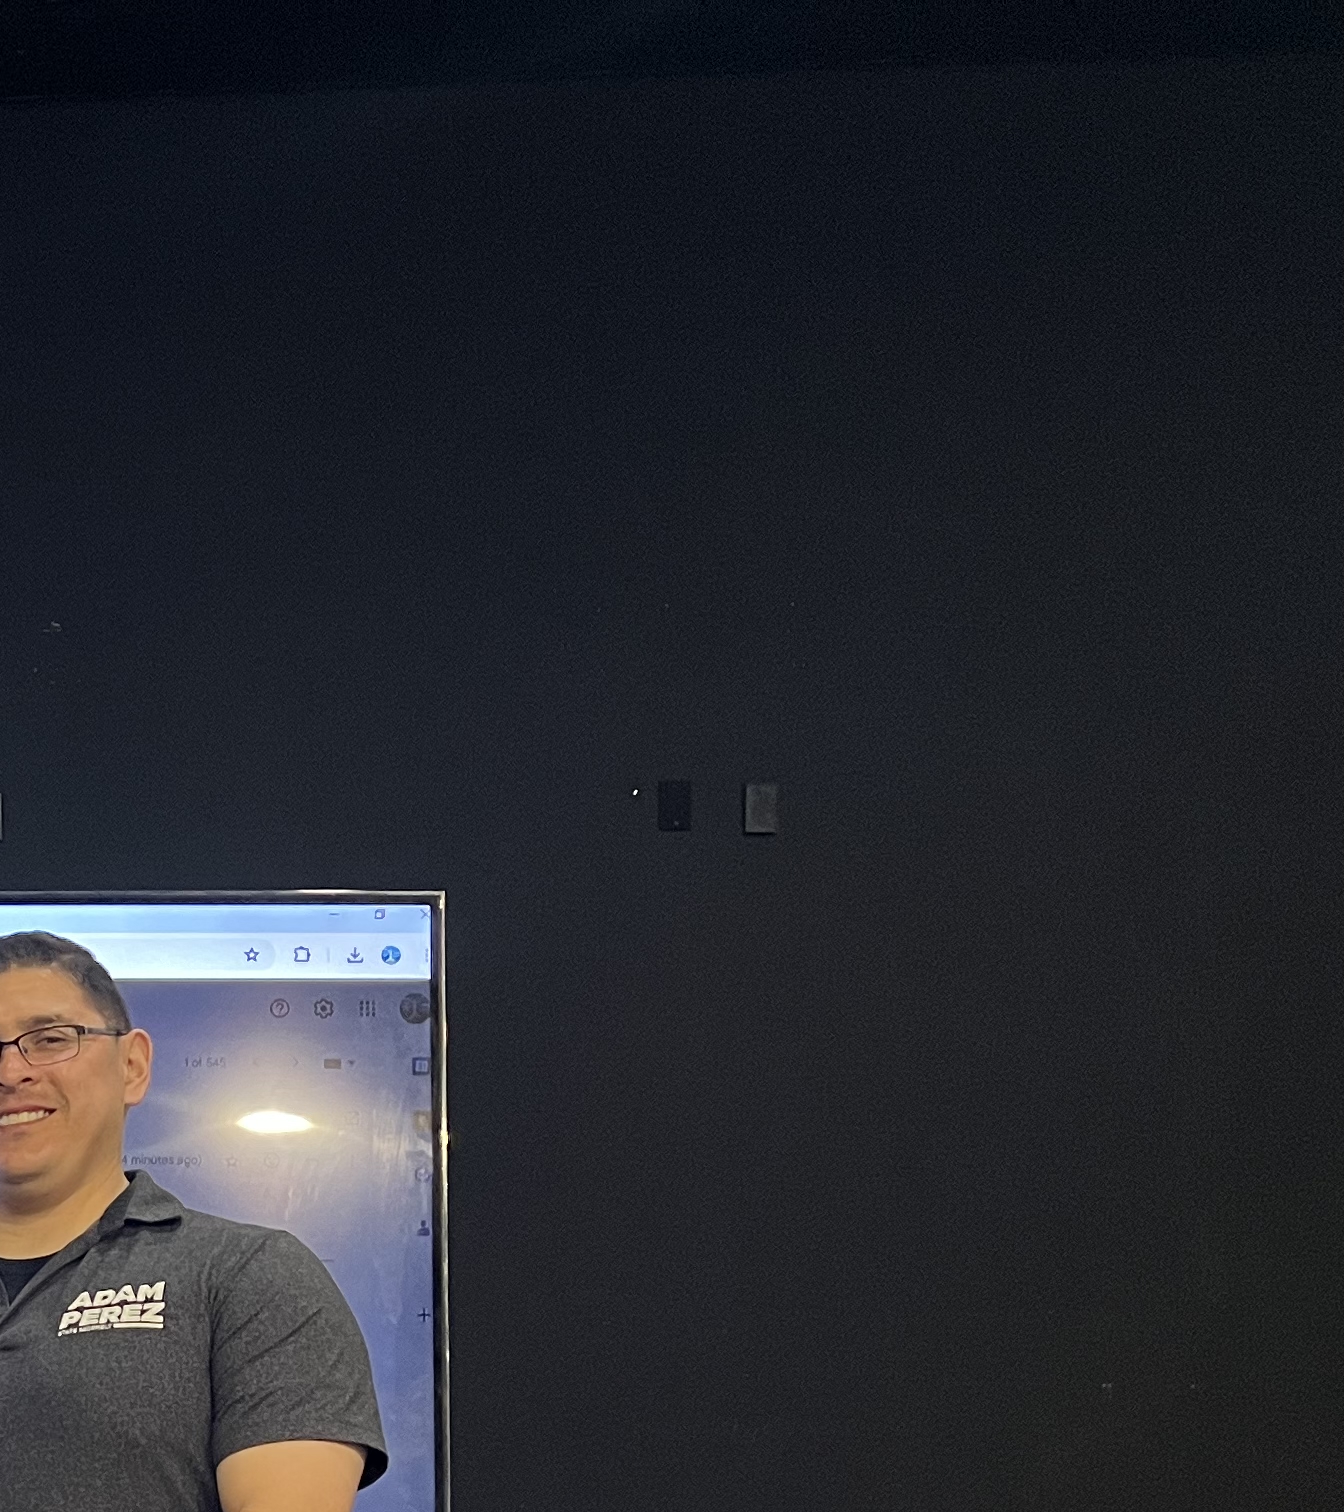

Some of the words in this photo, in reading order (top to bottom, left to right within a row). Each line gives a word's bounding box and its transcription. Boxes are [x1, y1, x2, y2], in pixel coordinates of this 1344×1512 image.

[130, 1153, 175, 1165] minutes
[67, 1281, 166, 1311] ADAM
[58, 1302, 166, 1331] PEREZ
